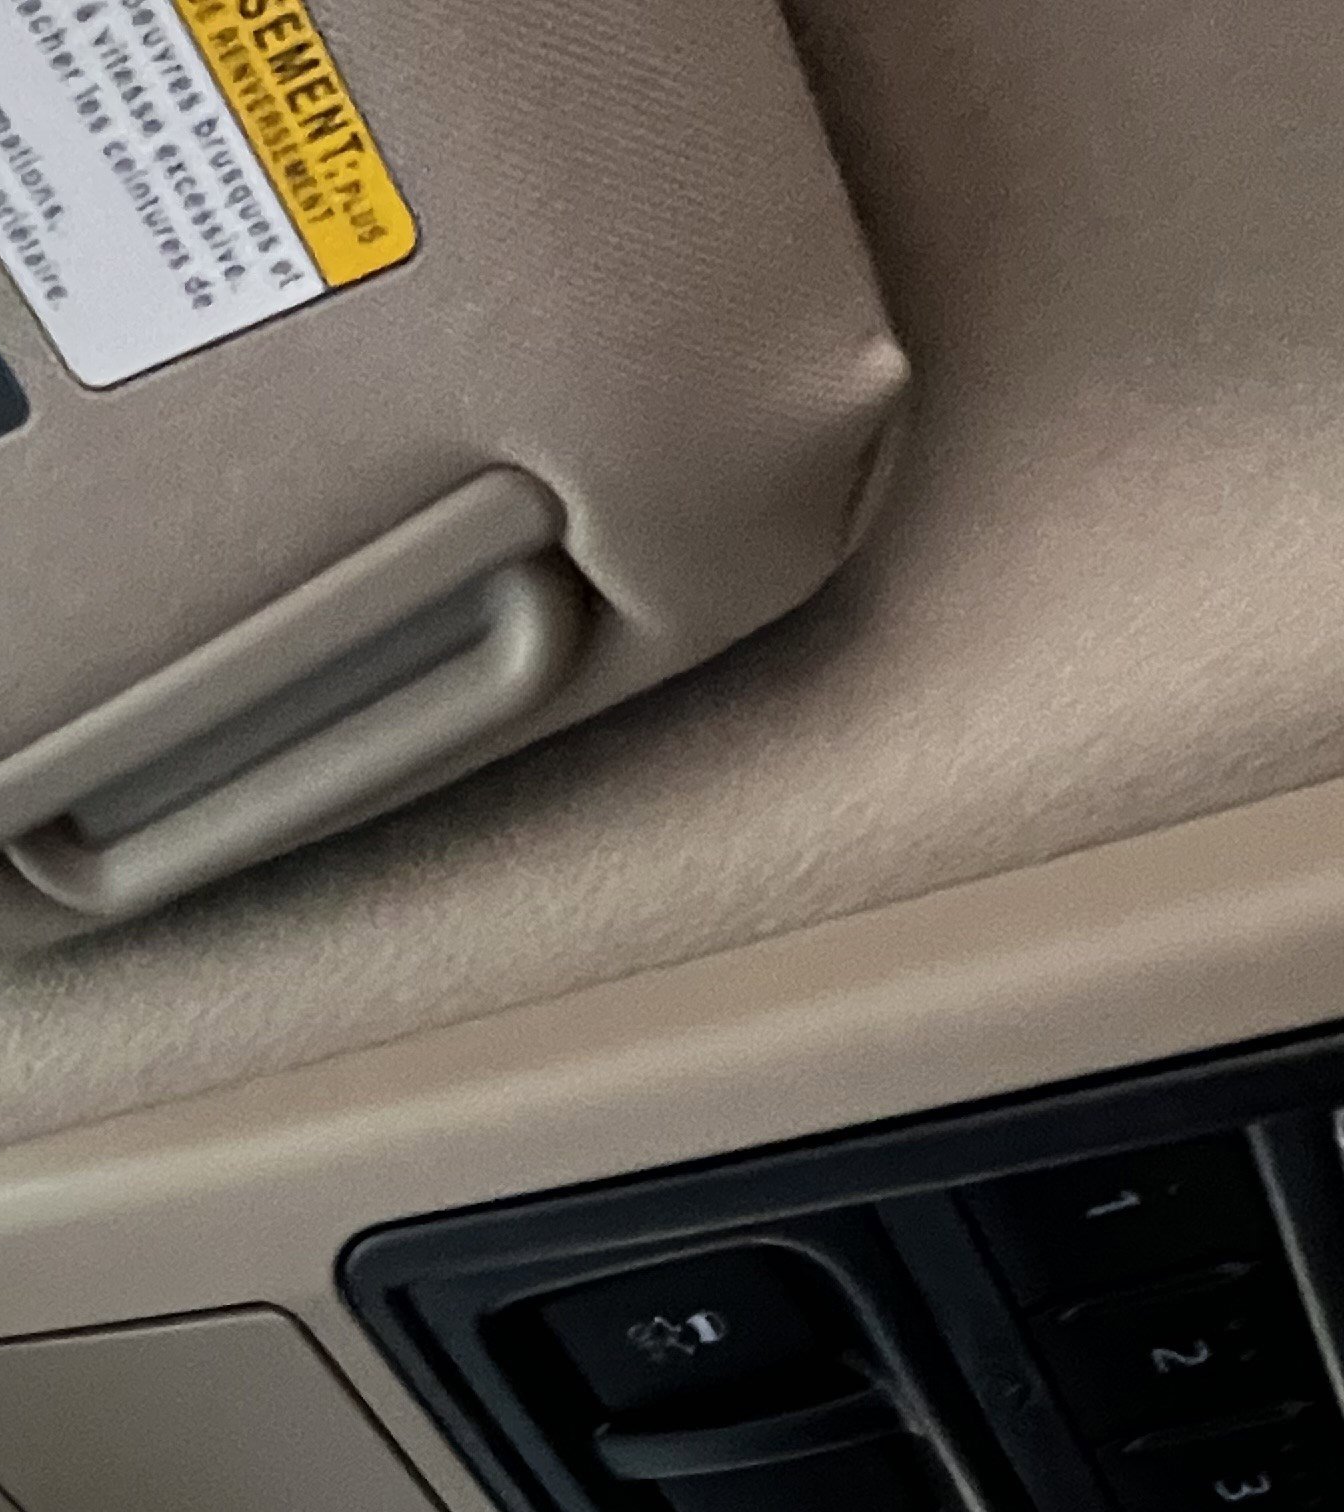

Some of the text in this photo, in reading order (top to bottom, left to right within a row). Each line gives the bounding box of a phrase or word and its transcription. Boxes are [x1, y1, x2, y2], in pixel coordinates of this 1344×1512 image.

[92, 25, 164, 136] vitesse
[75, 83, 111, 133] les
[103, 141, 190, 270] ceintures
[185, 276, 213, 309] de
[192, 117, 278, 252] brusques
[269, 260, 304, 289] et
[1086, 1190, 1141, 1219] 1
[1152, 1340, 1209, 1373] 2
[1215, 1472, 1270, 1501] 3
